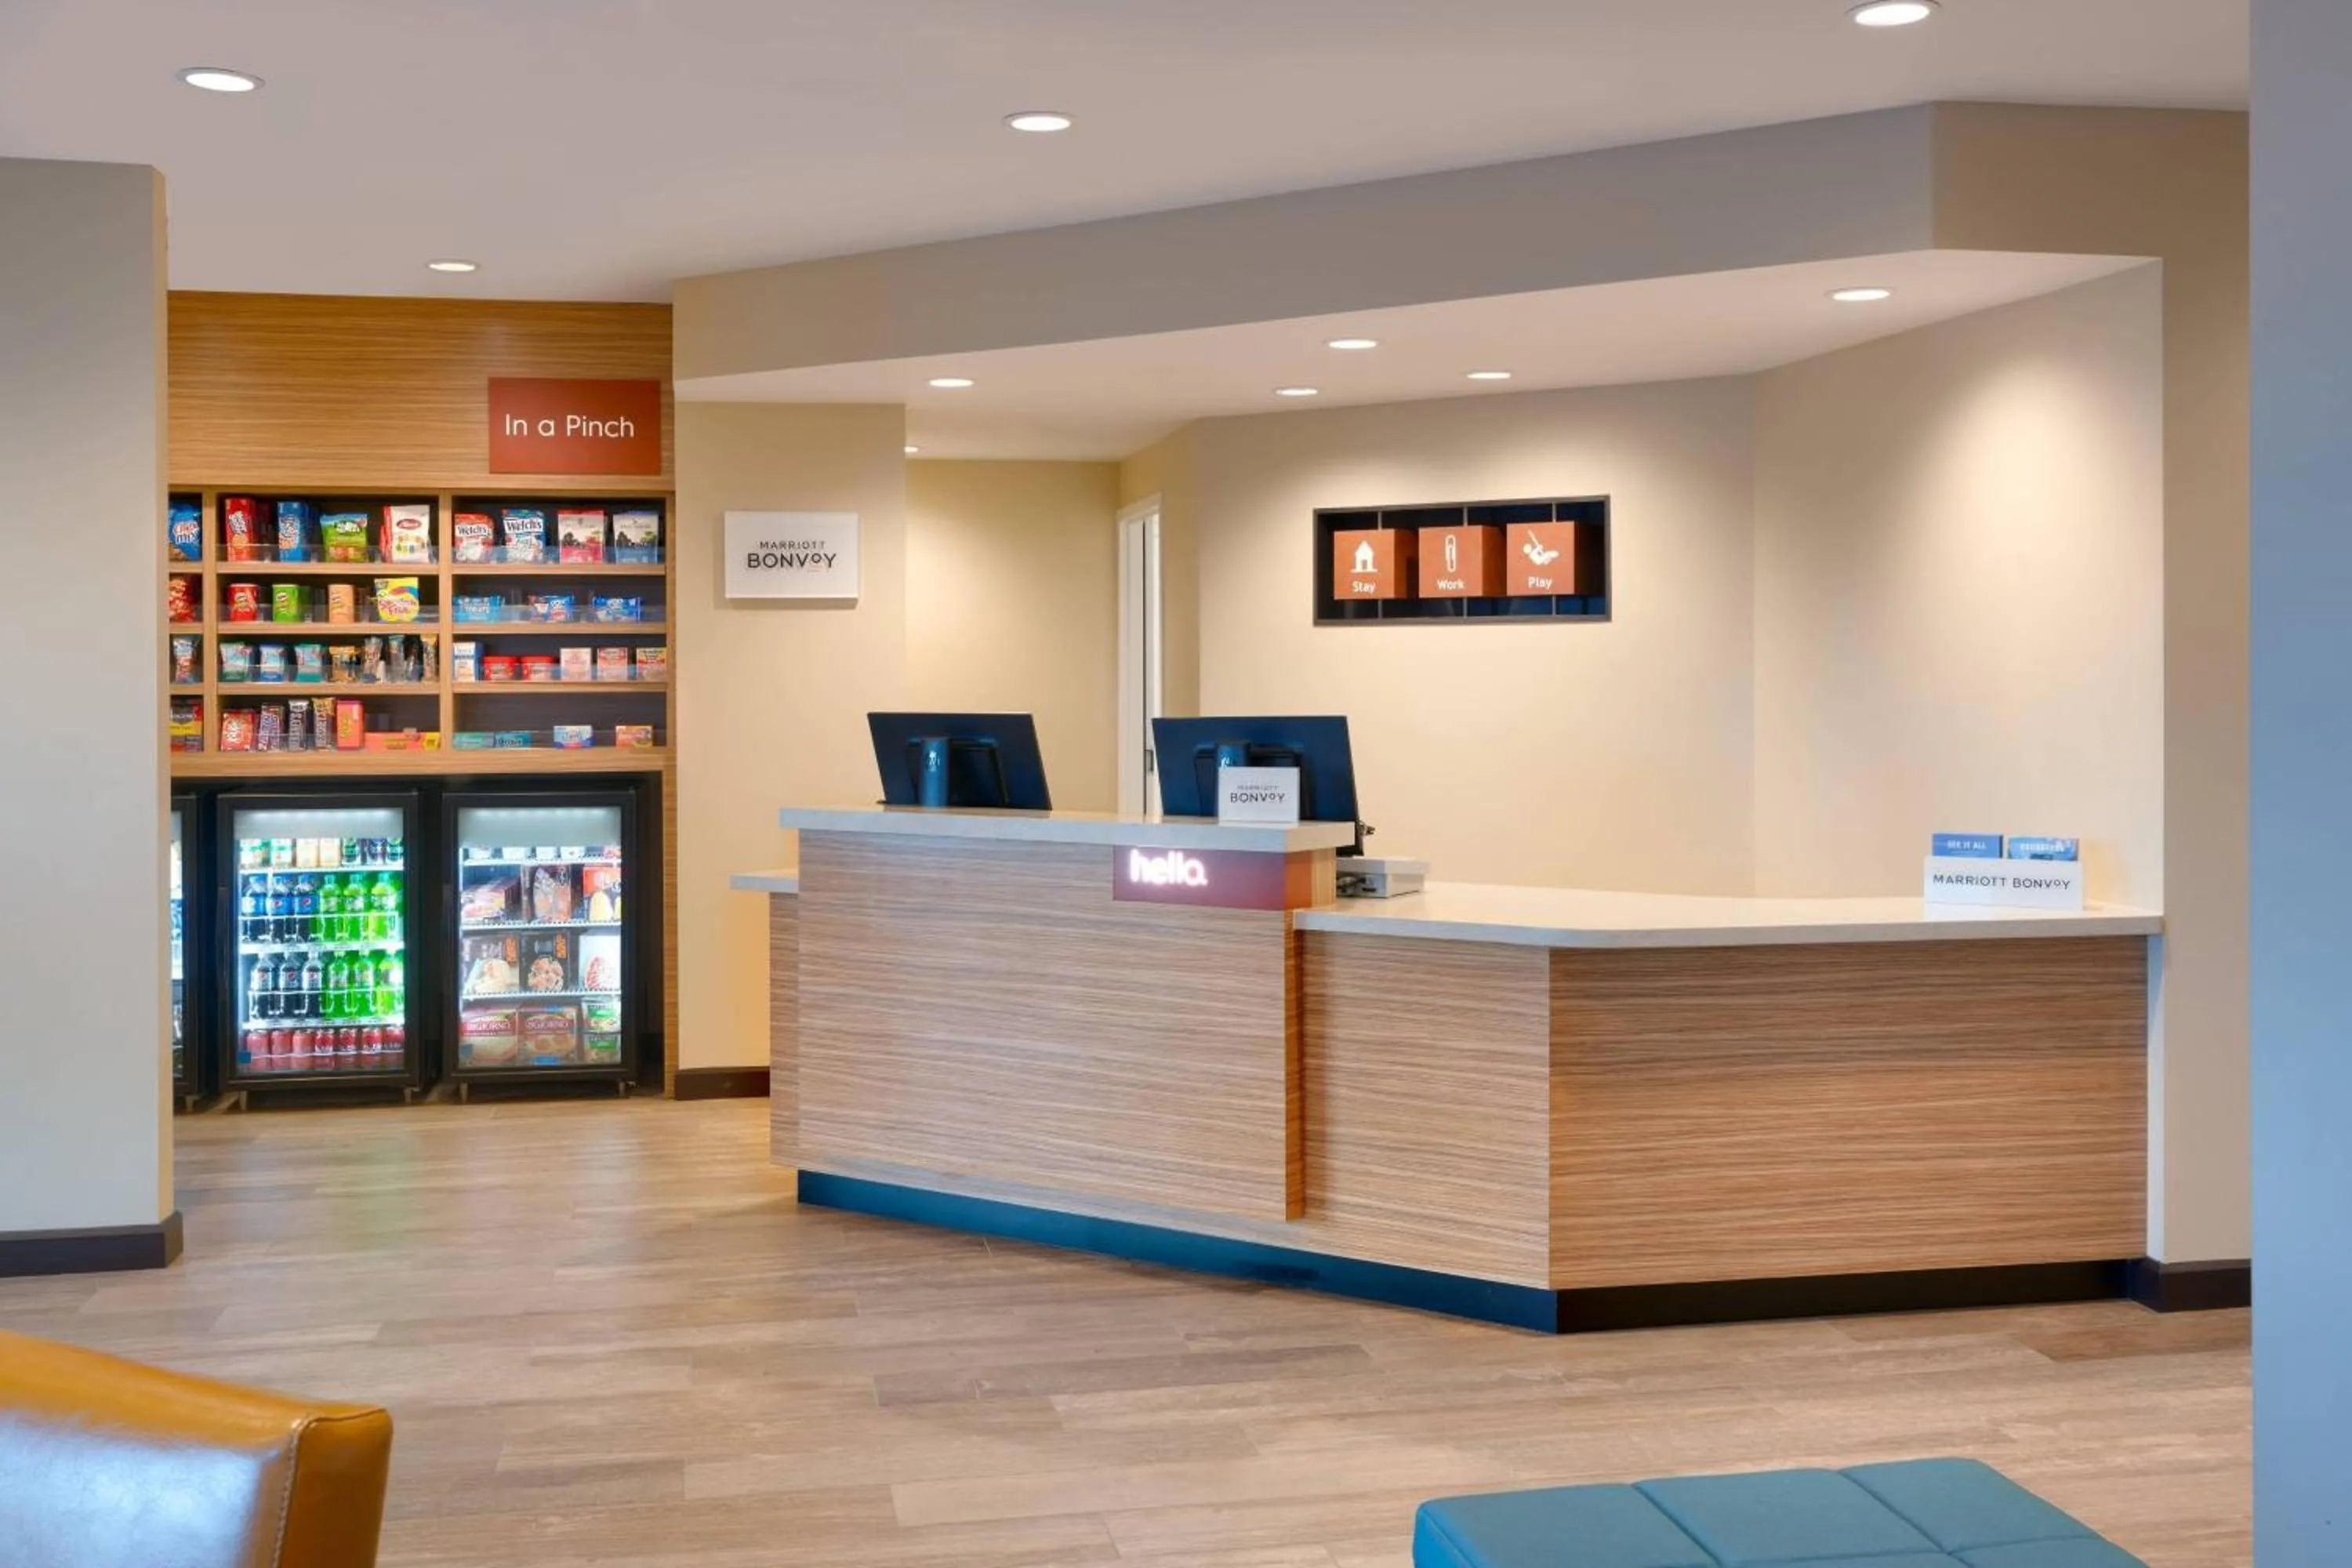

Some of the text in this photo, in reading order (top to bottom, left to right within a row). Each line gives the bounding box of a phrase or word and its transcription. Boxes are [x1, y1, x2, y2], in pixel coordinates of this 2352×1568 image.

[505, 413, 634, 437] In a Pinch
[760, 541, 826, 550] MARRIOTT
[747, 553, 837, 568] BONVOY
[1352, 581, 1376, 593] Stay
[1437, 578, 1465, 590] Work
[1528, 576, 1553, 590] Play
[1230, 793, 1285, 803] BONVOY
[1933, 874, 2071, 890] MARRIOTT BONVOY
